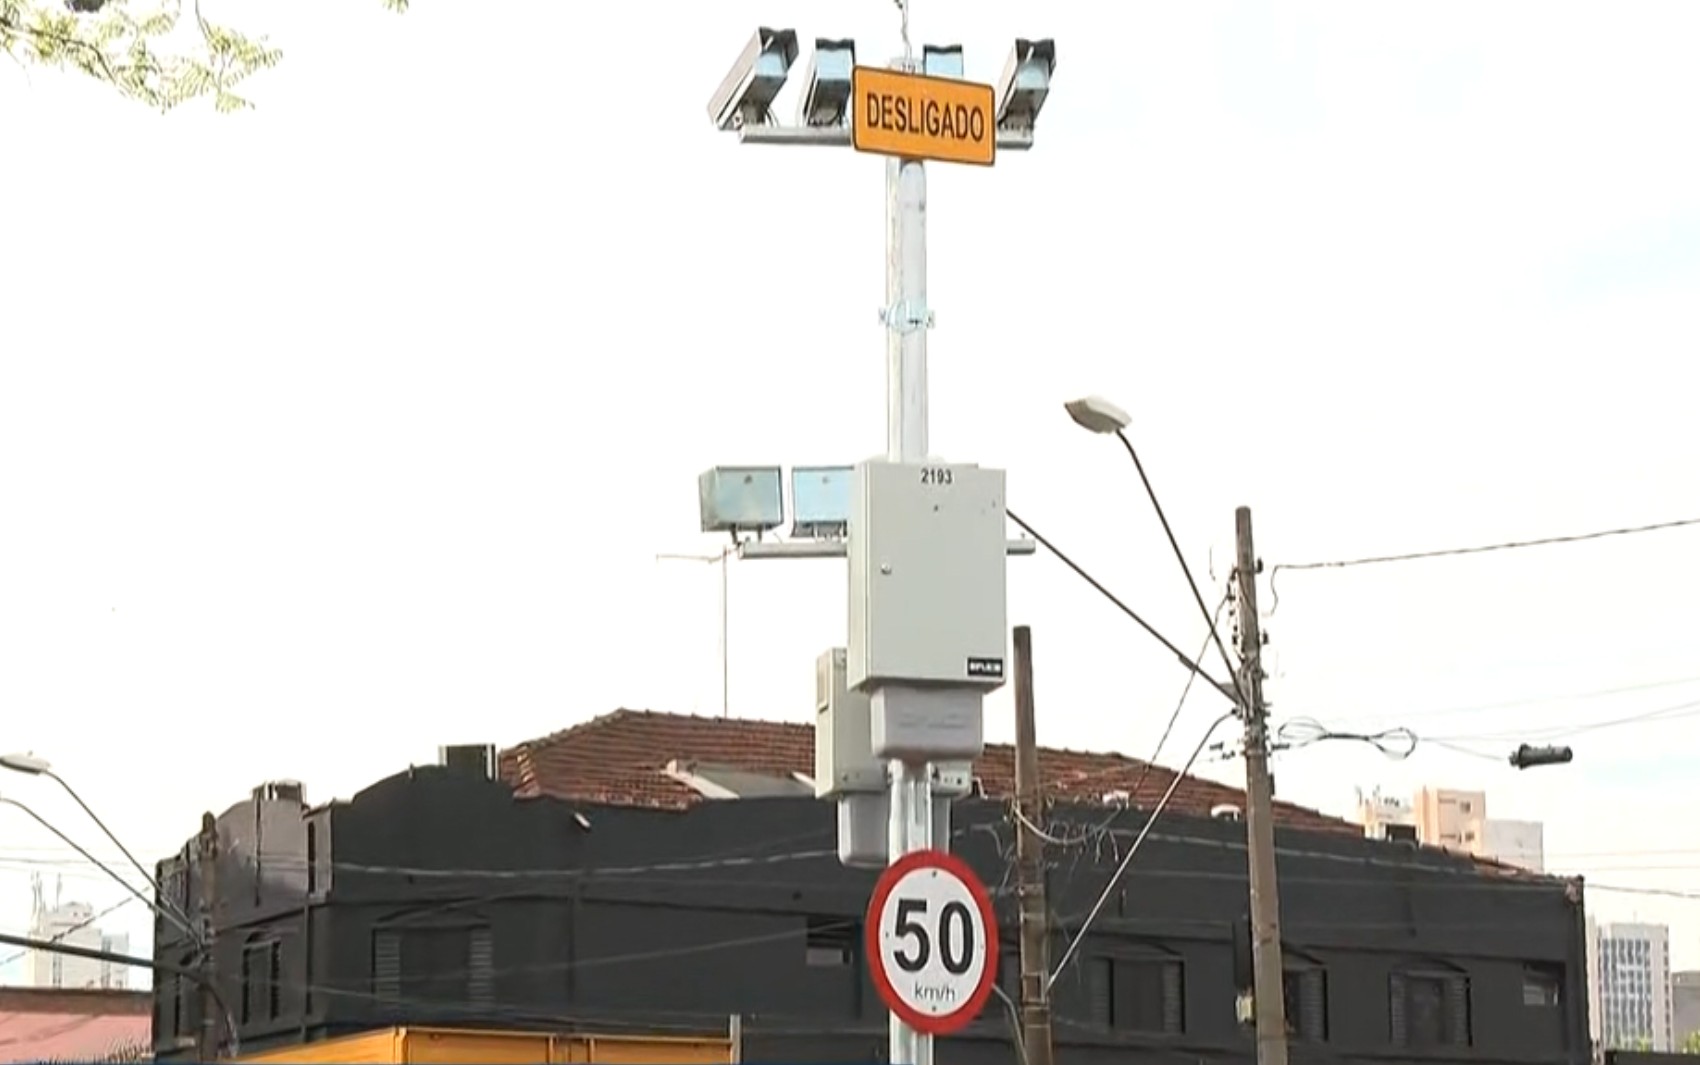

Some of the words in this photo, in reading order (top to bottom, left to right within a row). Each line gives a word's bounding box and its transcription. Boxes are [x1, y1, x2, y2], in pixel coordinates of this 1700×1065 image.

[866, 92, 985, 143] DESLIGADO
[920, 468, 953, 484] 2193
[893, 898, 974, 975] 50
[914, 981, 955, 1001] km/h
